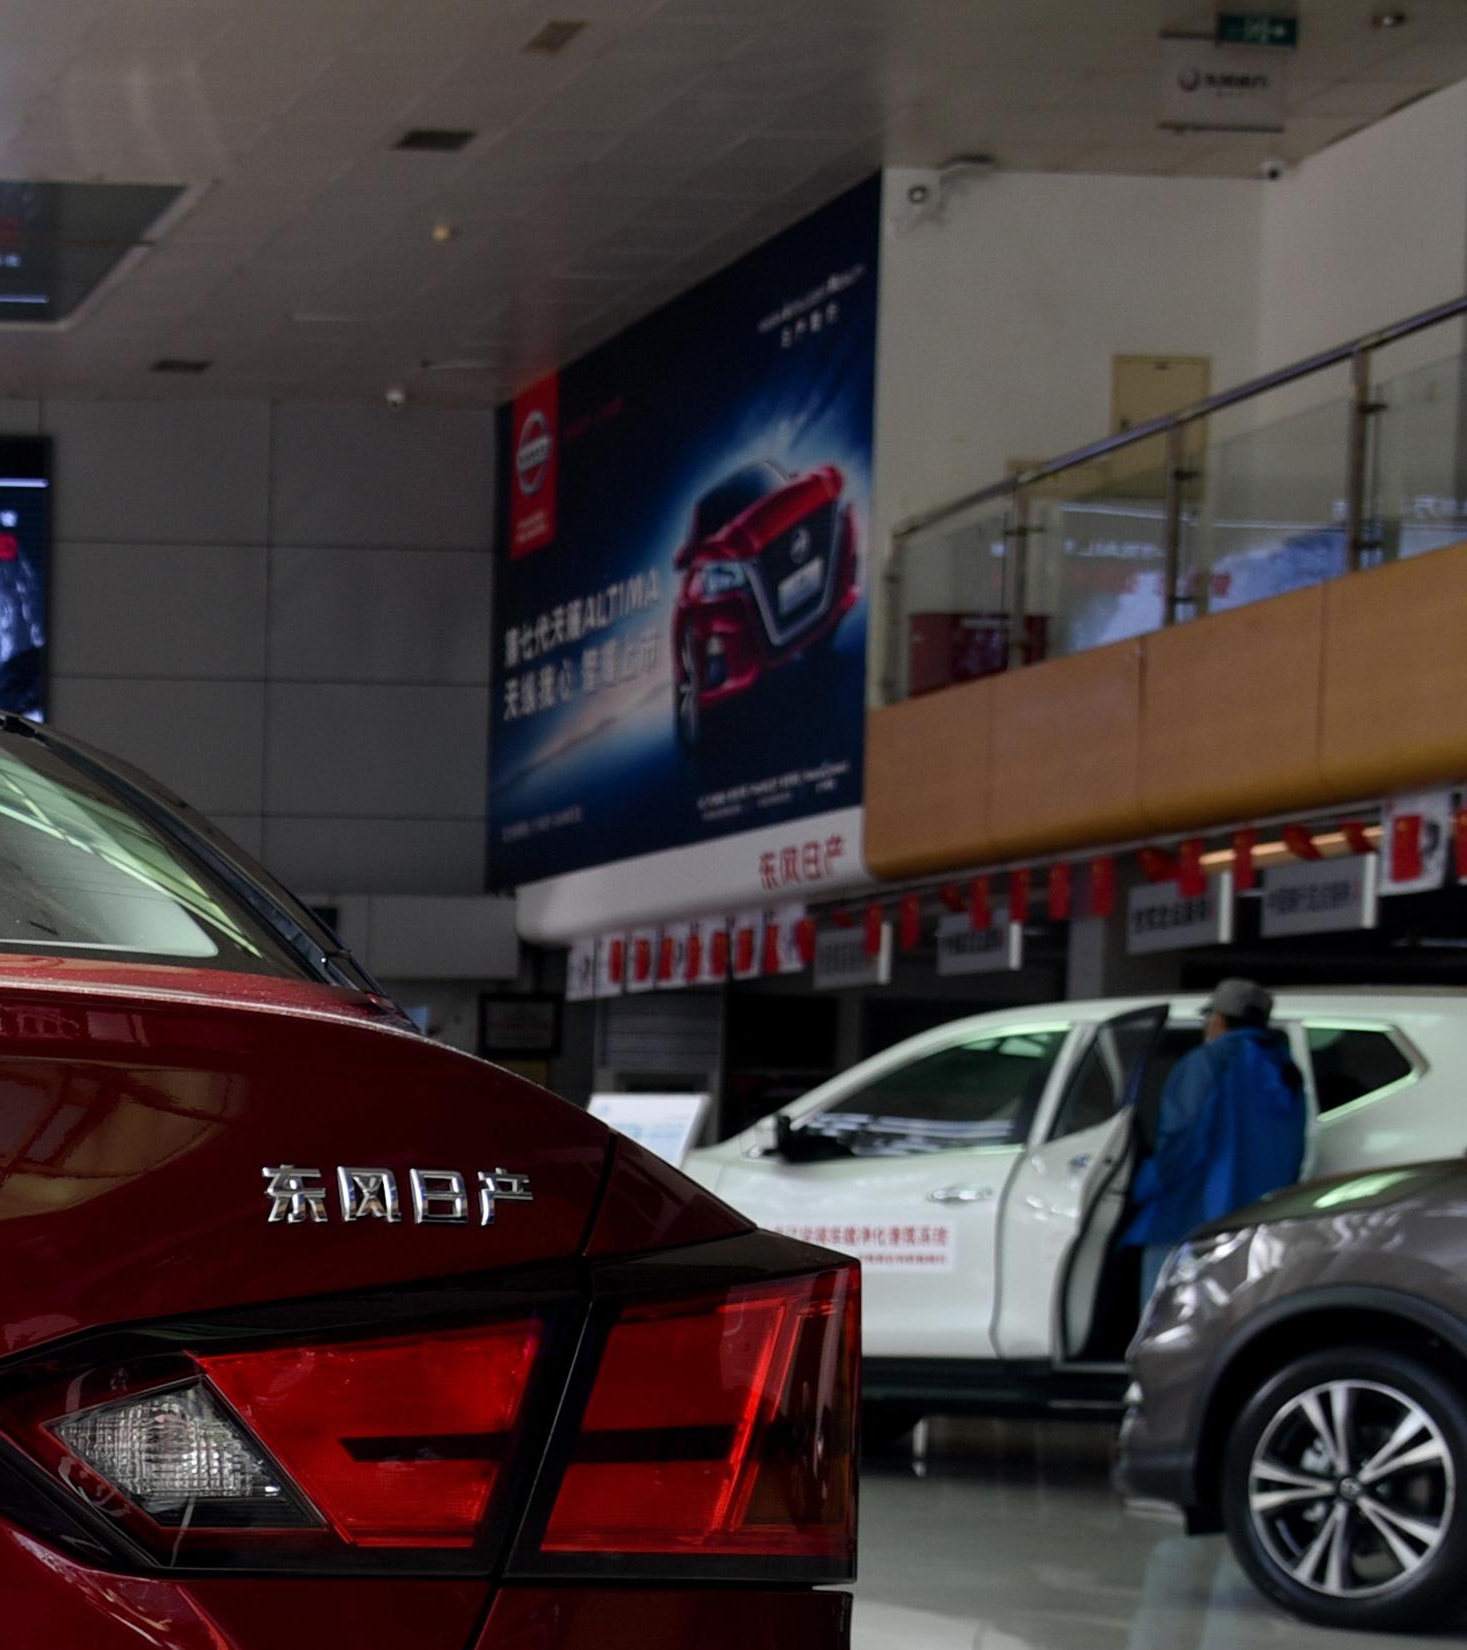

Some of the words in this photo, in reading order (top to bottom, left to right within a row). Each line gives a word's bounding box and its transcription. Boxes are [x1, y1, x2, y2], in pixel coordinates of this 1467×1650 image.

[759, 833, 844, 891] 东风日产
[262, 1164, 534, 1227] 东风日产
